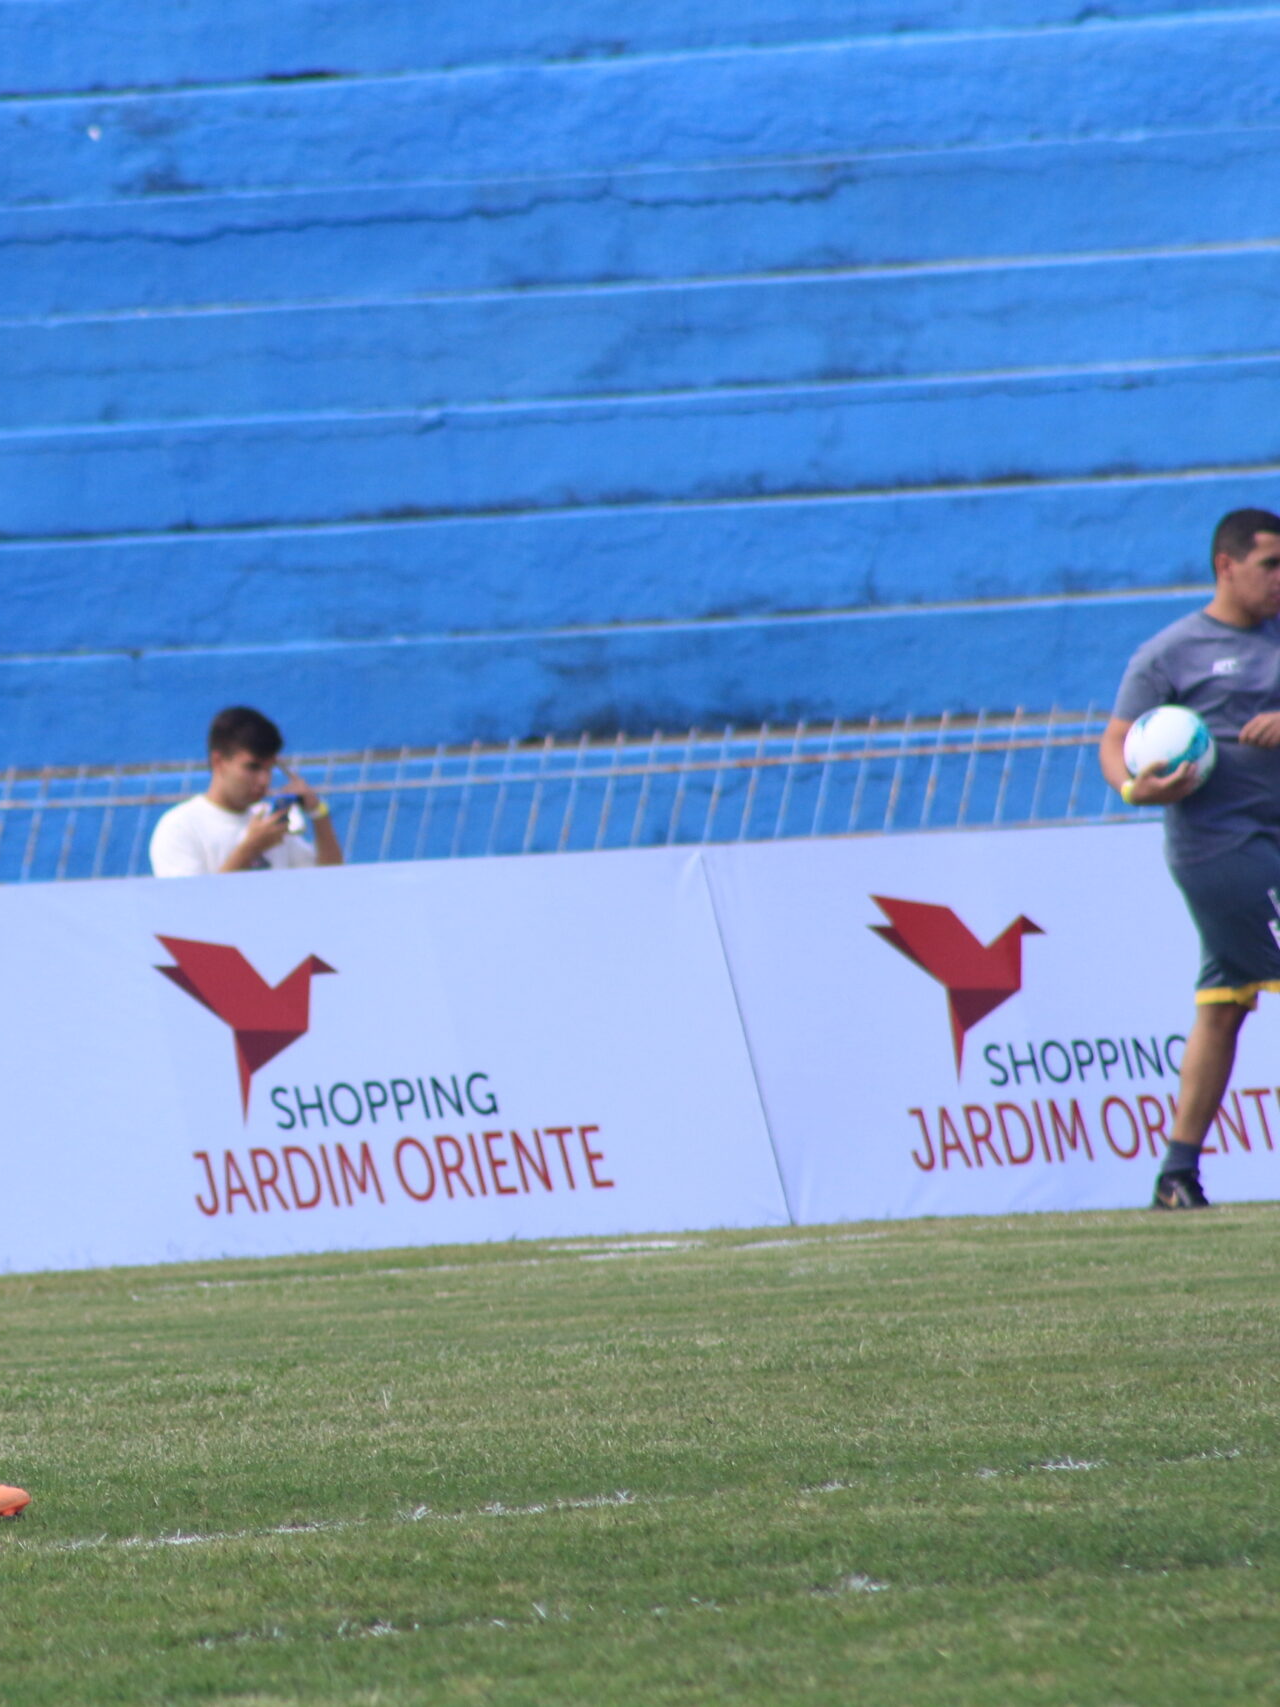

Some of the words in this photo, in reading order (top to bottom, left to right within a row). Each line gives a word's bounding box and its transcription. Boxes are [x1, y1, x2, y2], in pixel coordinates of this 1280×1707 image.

[270, 1072, 499, 1130] SHOPPING
[908, 1098, 1094, 1172] JARDIM
[193, 1142, 386, 1217] JARDIM
[393, 1125, 615, 1202] ORIENTE
